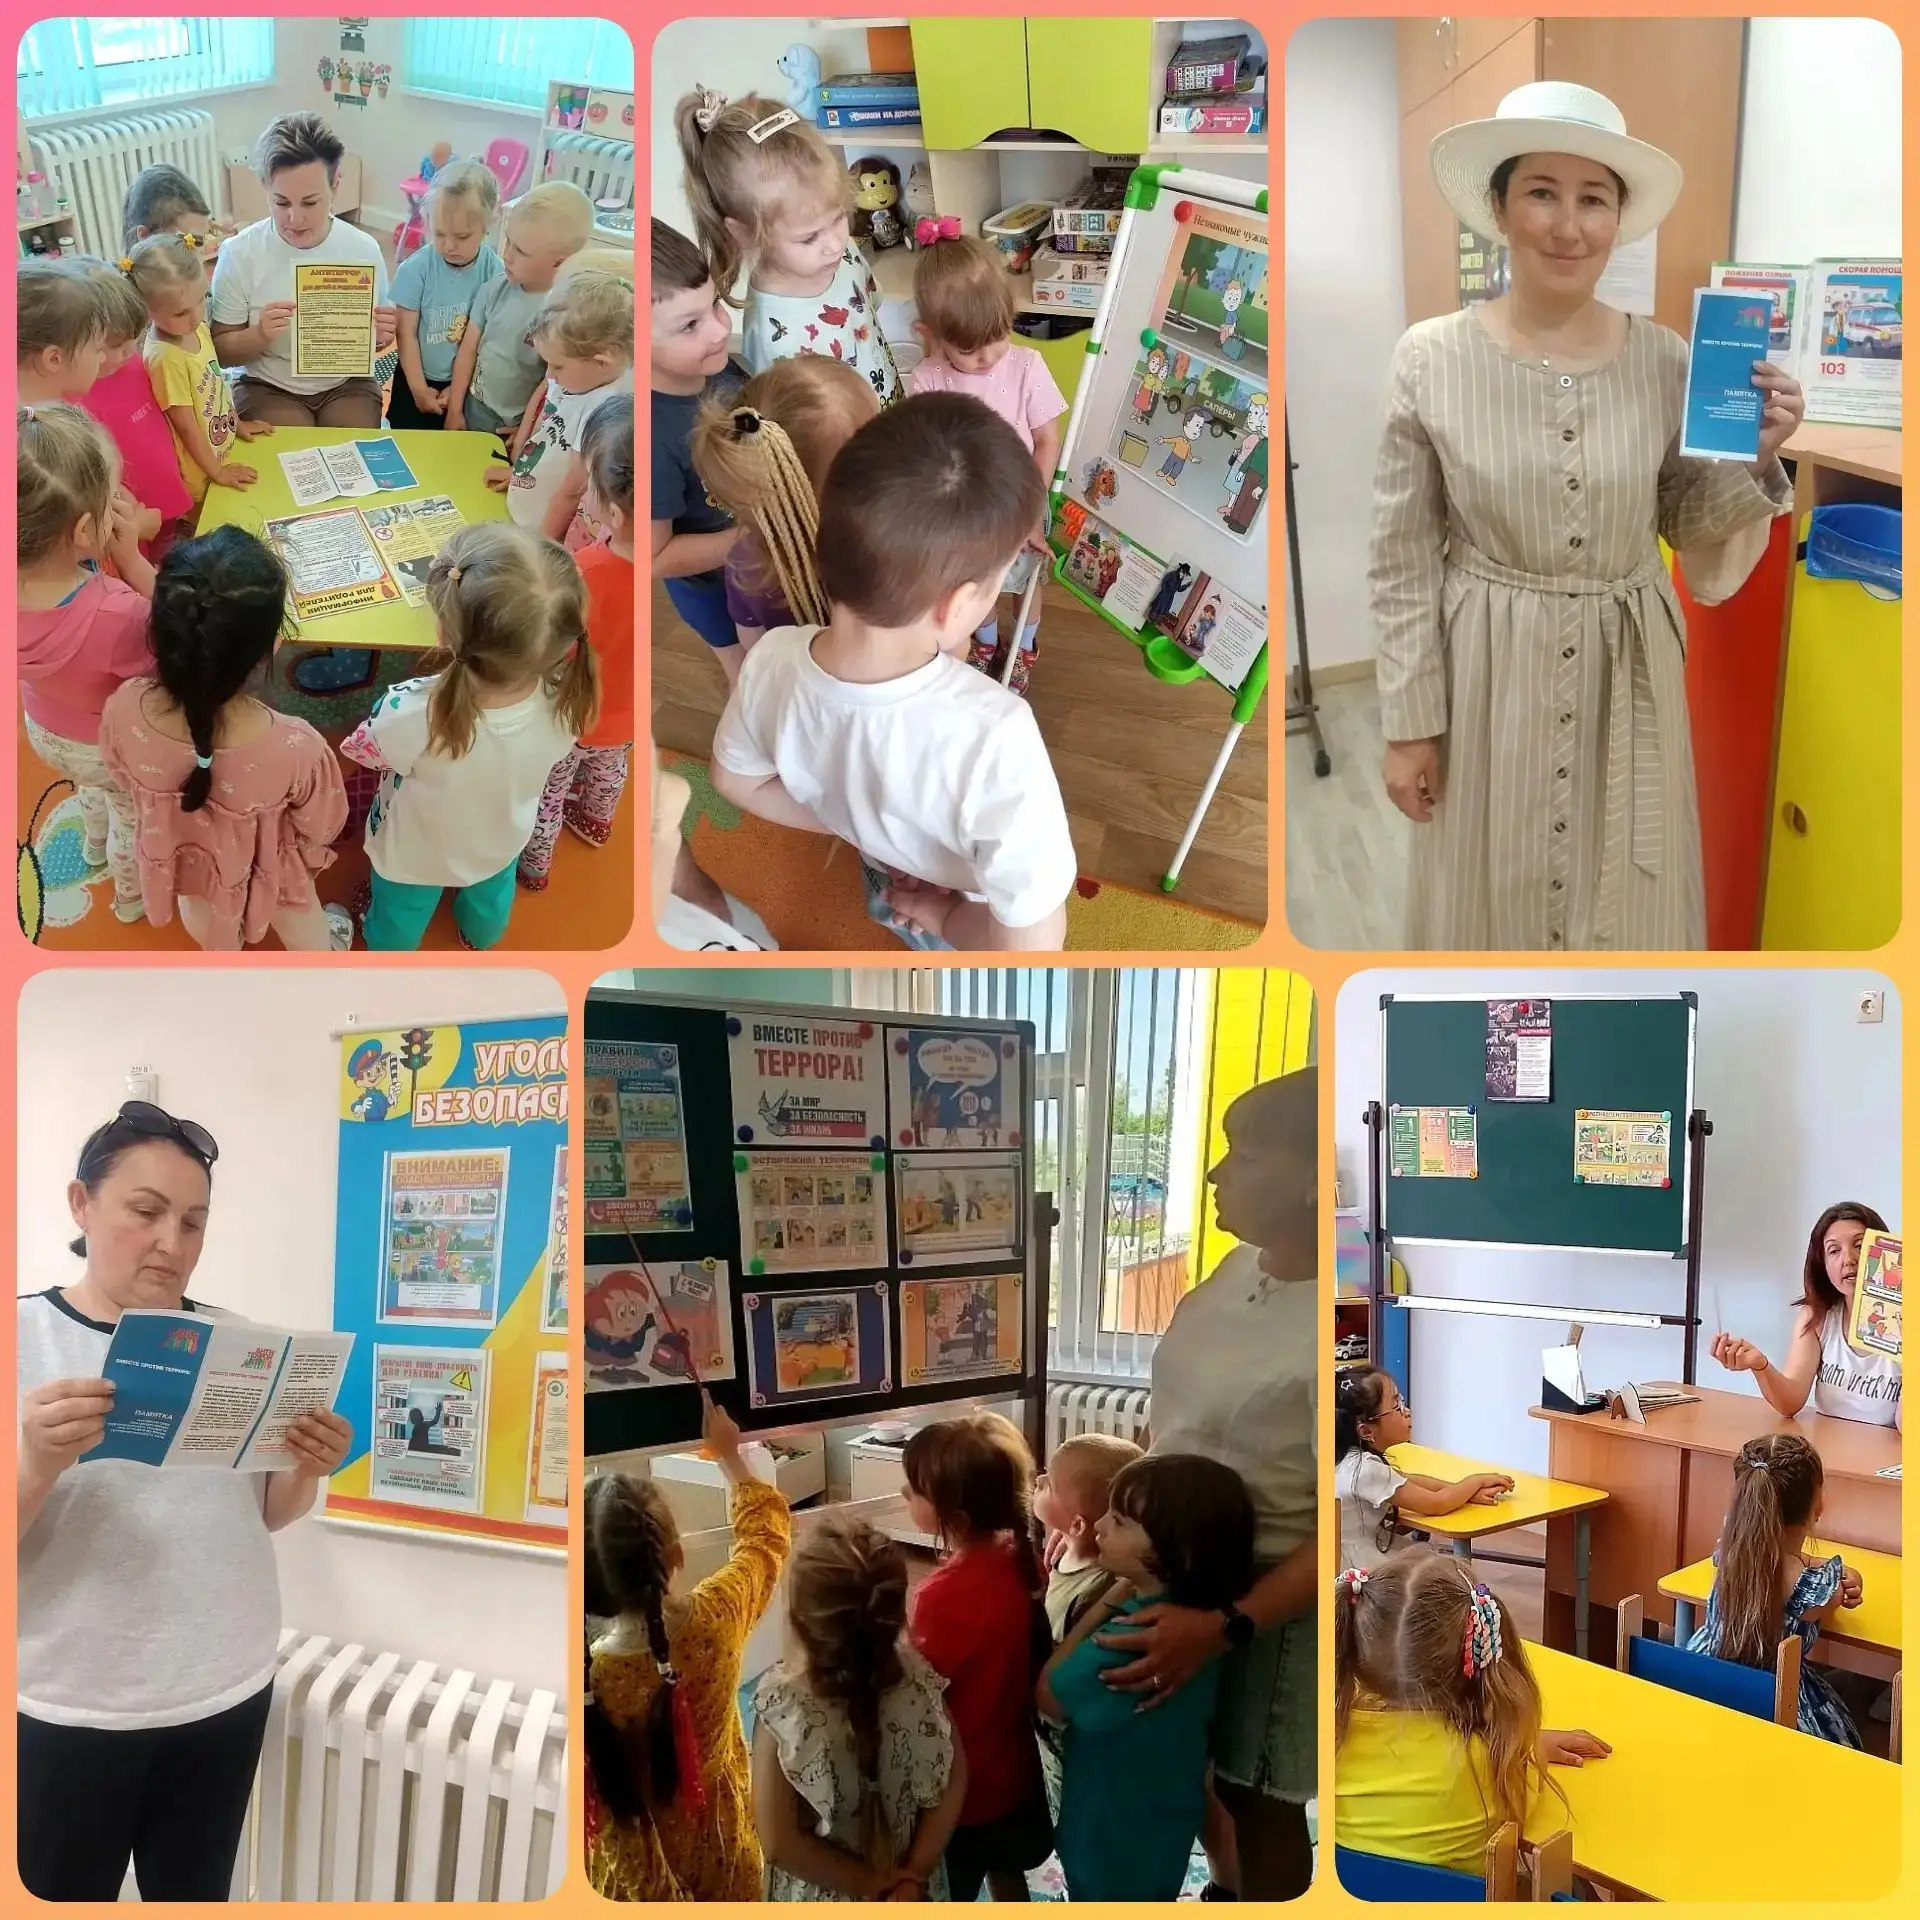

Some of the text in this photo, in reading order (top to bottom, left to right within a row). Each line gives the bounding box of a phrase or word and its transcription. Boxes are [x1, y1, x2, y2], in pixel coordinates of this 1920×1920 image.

[883, 111, 893, 119] НА
[1193, 214, 1241, 237] Незнакомые
[1725, 270, 1793, 279] ПОЖАРНАЯ ОХРАНА
[1838, 266, 1869, 274] СКОРАЯ
[1820, 362, 1846, 375] 103
[1724, 389, 1758, 398] ПАМЯТКА
[299, 585, 375, 609] ДЛЯ РОДИТЕЛЕЙ
[307, 595, 375, 615] ИНФОРМАЦИЯ
[753, 1025, 863, 1049] ВМЕСТЕ ПРОТИВ
[754, 1048, 864, 1081] ТЕРРОРА!
[789, 1096, 821, 1108] ЗА МИР
[790, 1110, 864, 1123] ЗА БЕЗОПАСНОСТЬ
[790, 1124, 801, 1134] ЗА
[396, 1158, 500, 1174] ВНИМАНИЕ:
[116, 1358, 139, 1367] ВМЕСТЕ
[140, 1362, 164, 1371] ПРОТИВ
[1818, 1363, 1845, 1387] eam
[1847, 1370, 1884, 1399] with
[135, 1409, 173, 1420] ПАМЯТКА
